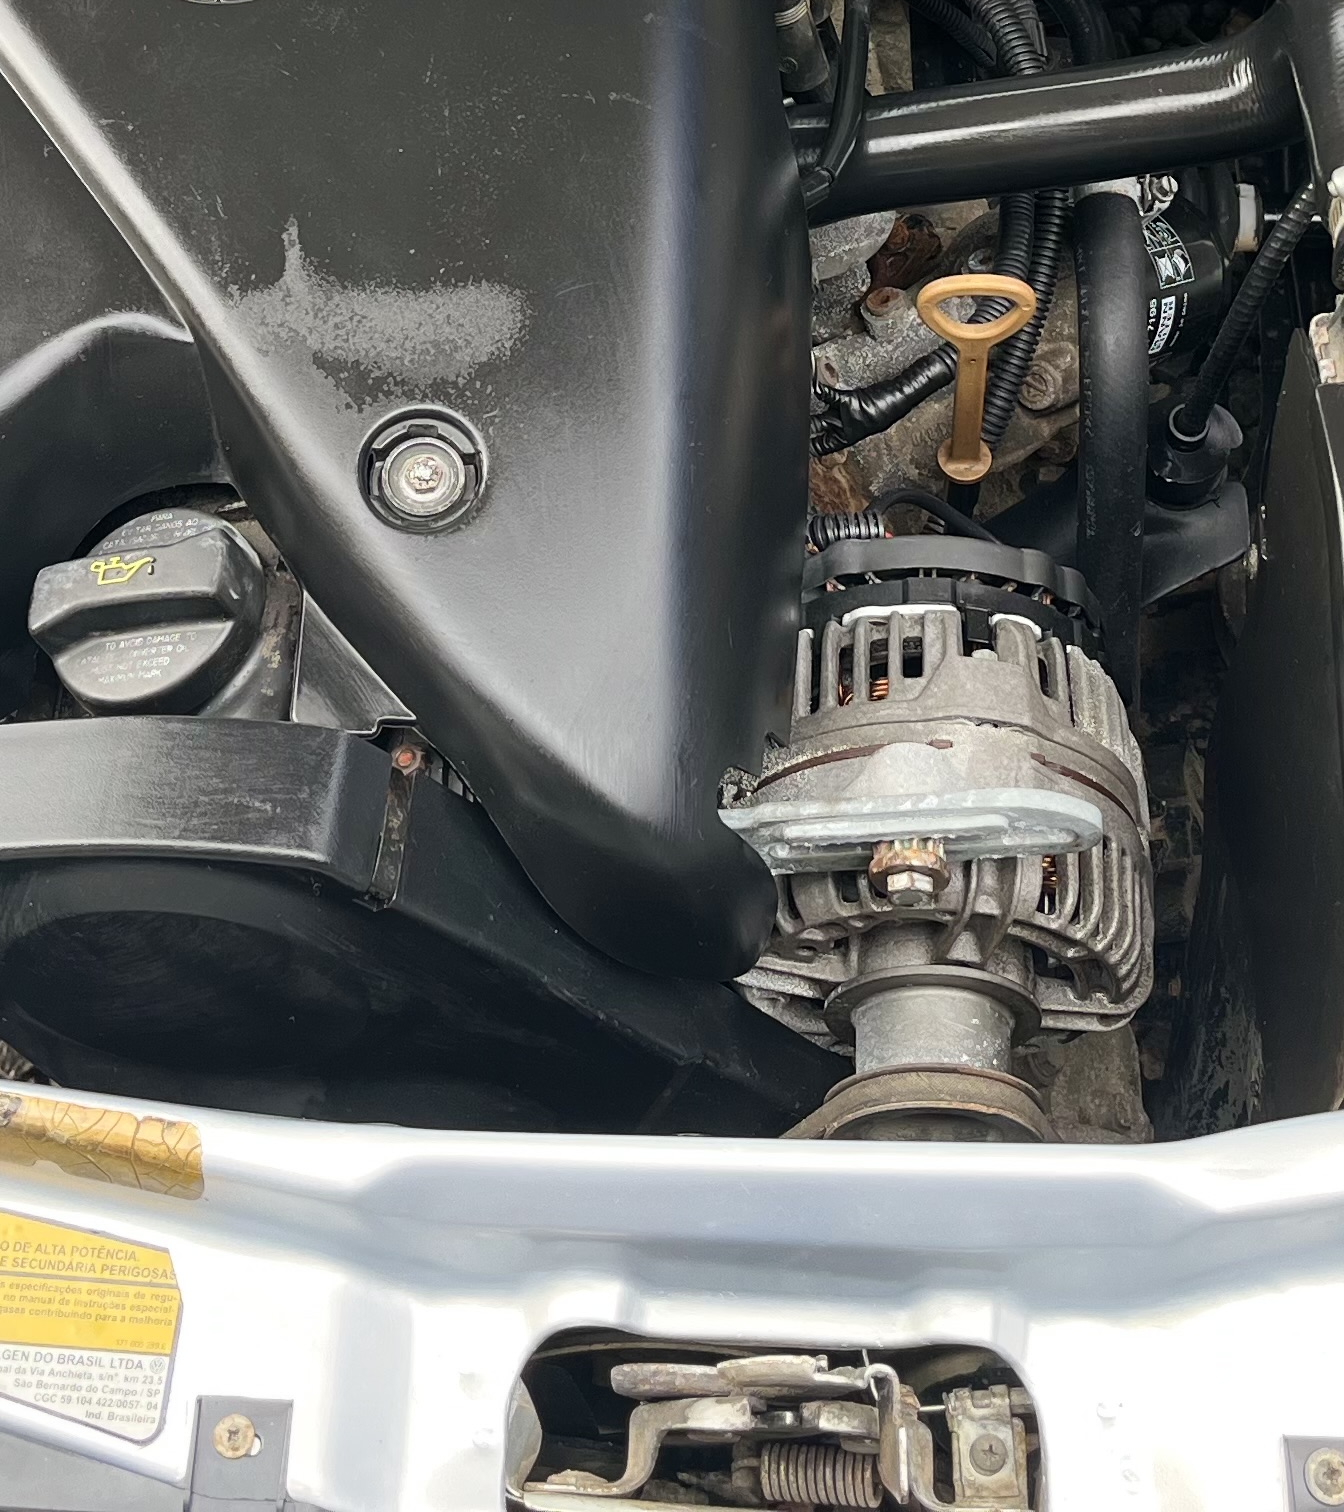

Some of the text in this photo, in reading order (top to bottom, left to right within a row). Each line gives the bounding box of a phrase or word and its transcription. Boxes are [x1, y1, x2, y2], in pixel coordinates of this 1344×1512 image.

[12, 1241, 32, 1253] DE
[34, 1243, 66, 1256] ALTA
[0, 1256, 9, 1267] E
[11, 1257, 96, 1274] SECUNDÁRIA
[100, 1264, 176, 1281] PERIGOSAS
[19, 1294, 55, 1304] manual
[33, 1352, 54, 1363] DO
[57, 1353, 106, 1368] BRASIL
[30, 1367, 45, 1376] Via
[36, 1379, 83, 1392] Bernardo
[85, 1384, 99, 1393] do
[146, 1388, 161, 1397] SP
[107, 1412, 156, 1424] Brasileira
